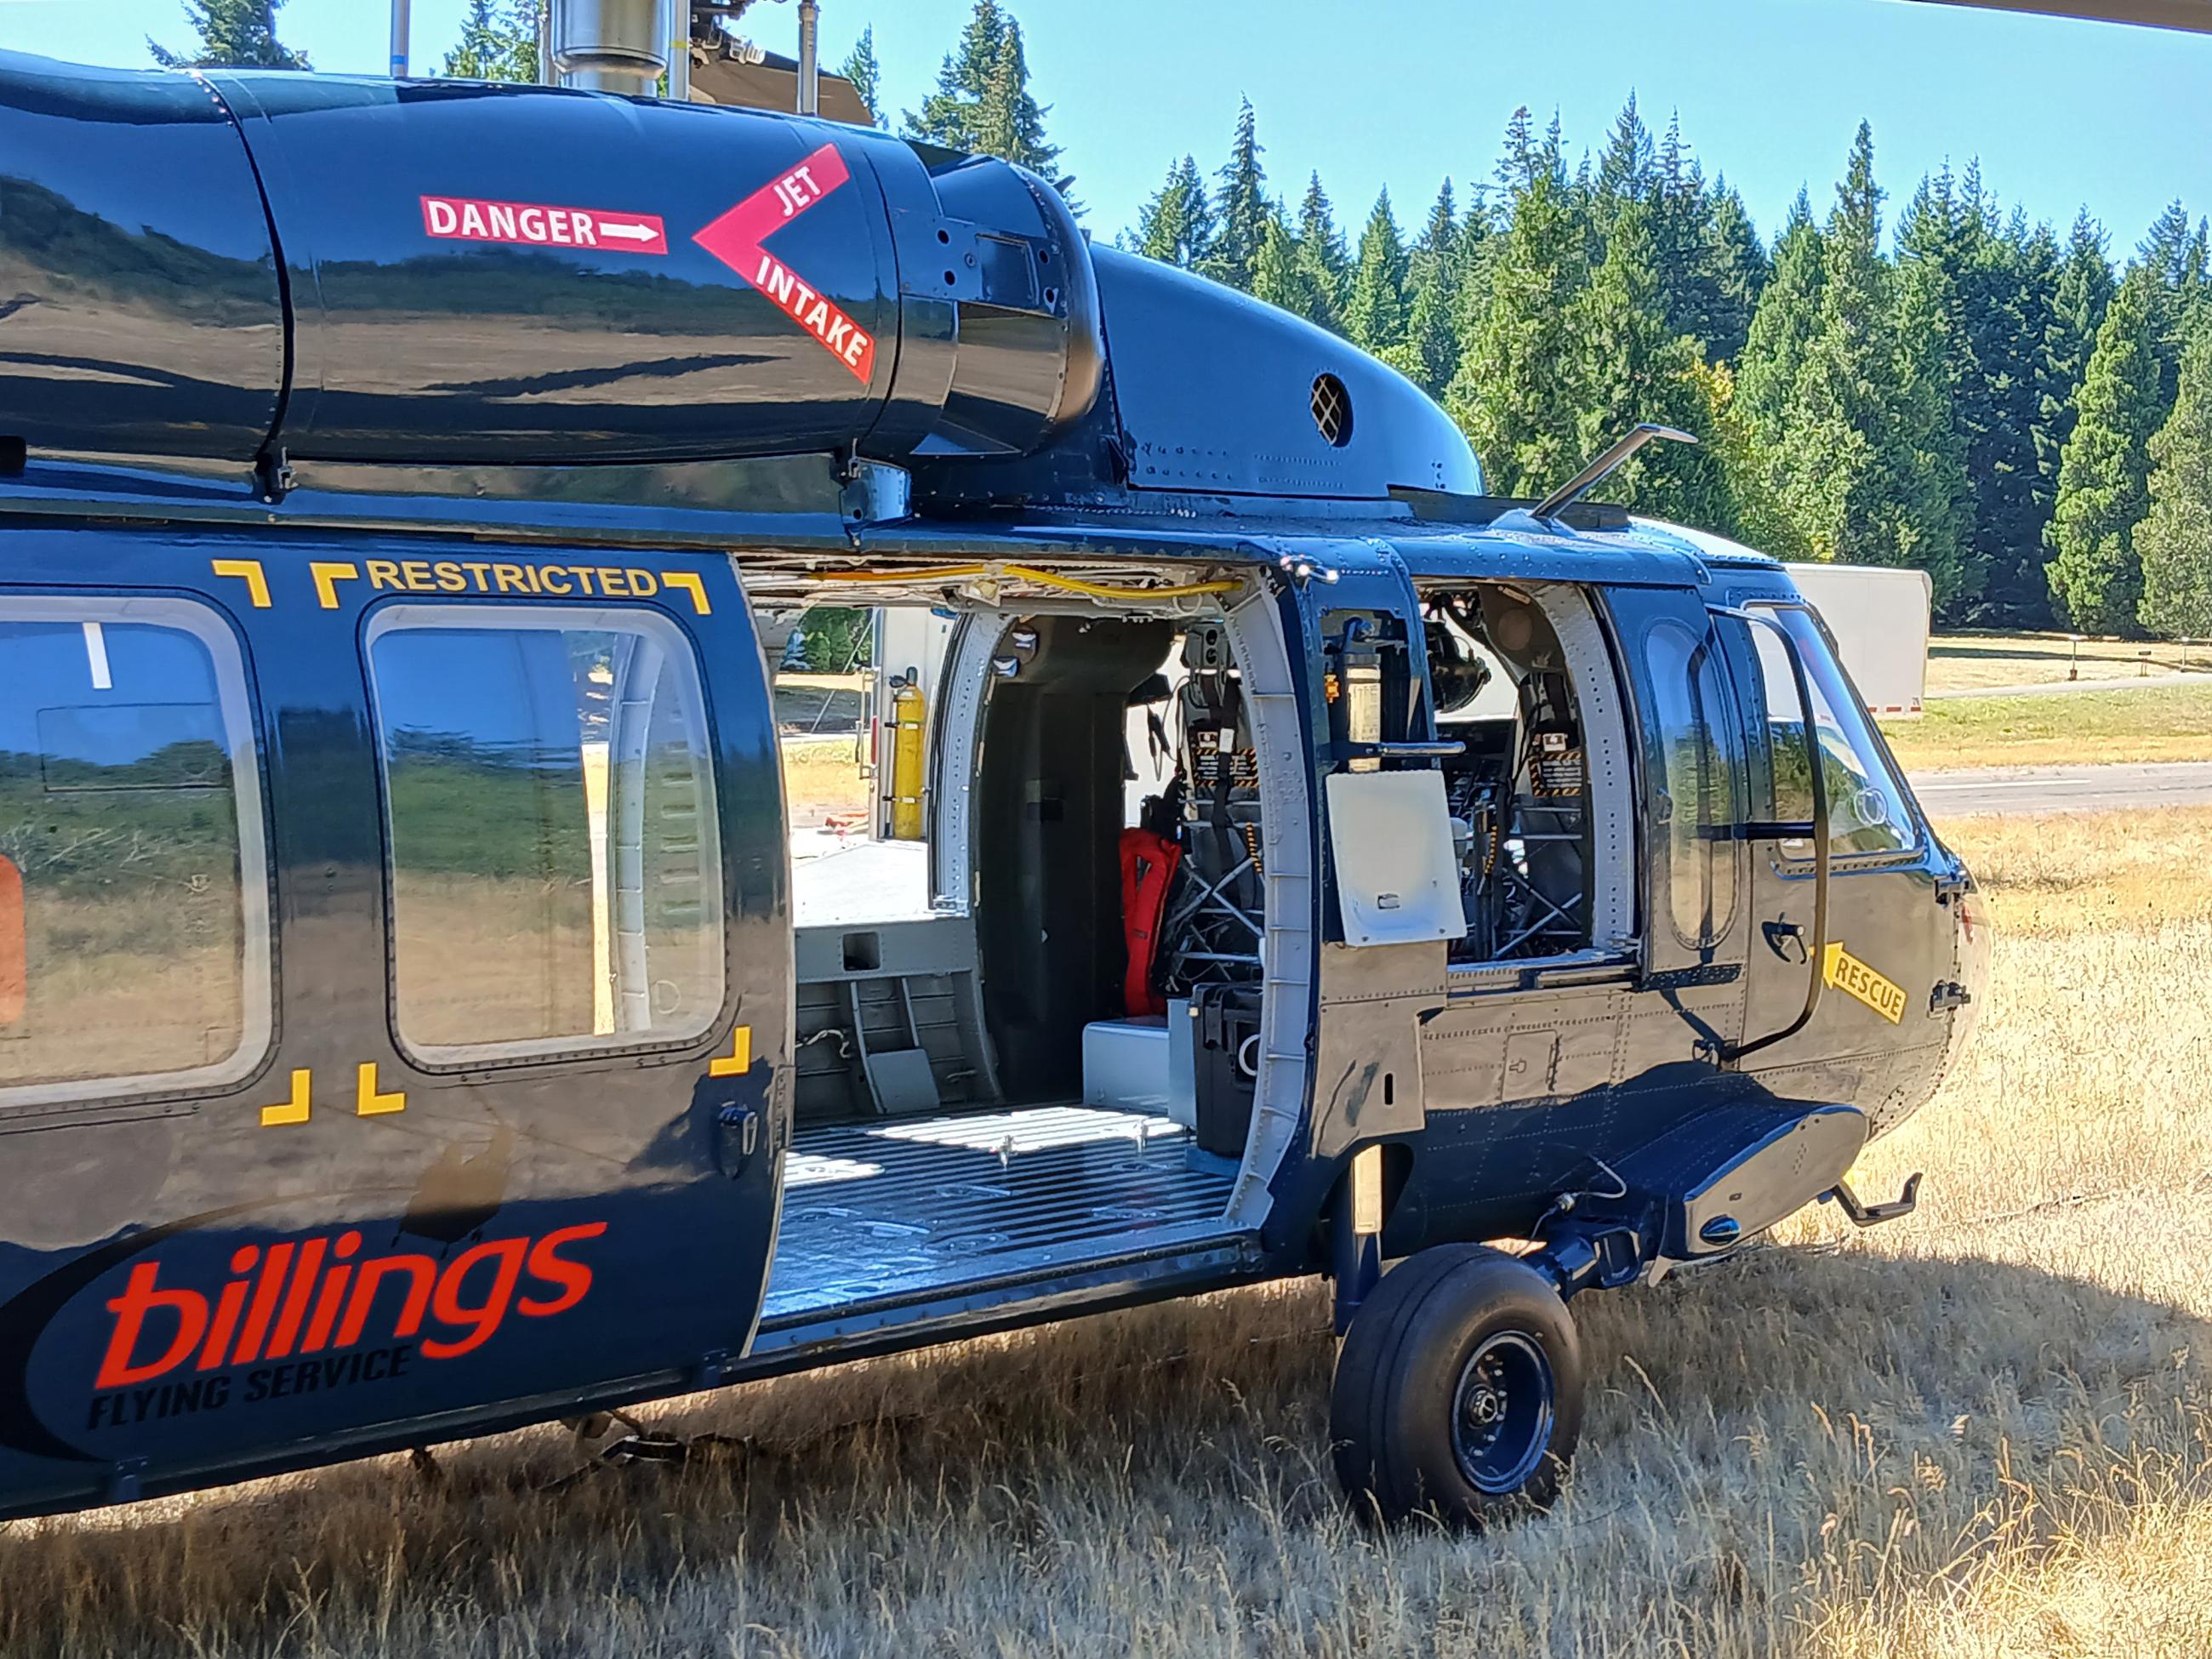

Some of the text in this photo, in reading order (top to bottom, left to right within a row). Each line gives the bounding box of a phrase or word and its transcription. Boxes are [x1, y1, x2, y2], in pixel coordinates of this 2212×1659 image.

[773, 165, 821, 217] JET
[427, 200, 597, 245] DANGER
[755, 255, 869, 368] INTAKE
[366, 560, 658, 597] RESTRICTED
[1835, 957, 1902, 1016] RESCUE
[94, 1222, 607, 1390] billings
[88, 1346, 413, 1431] FLYING SERVICE
